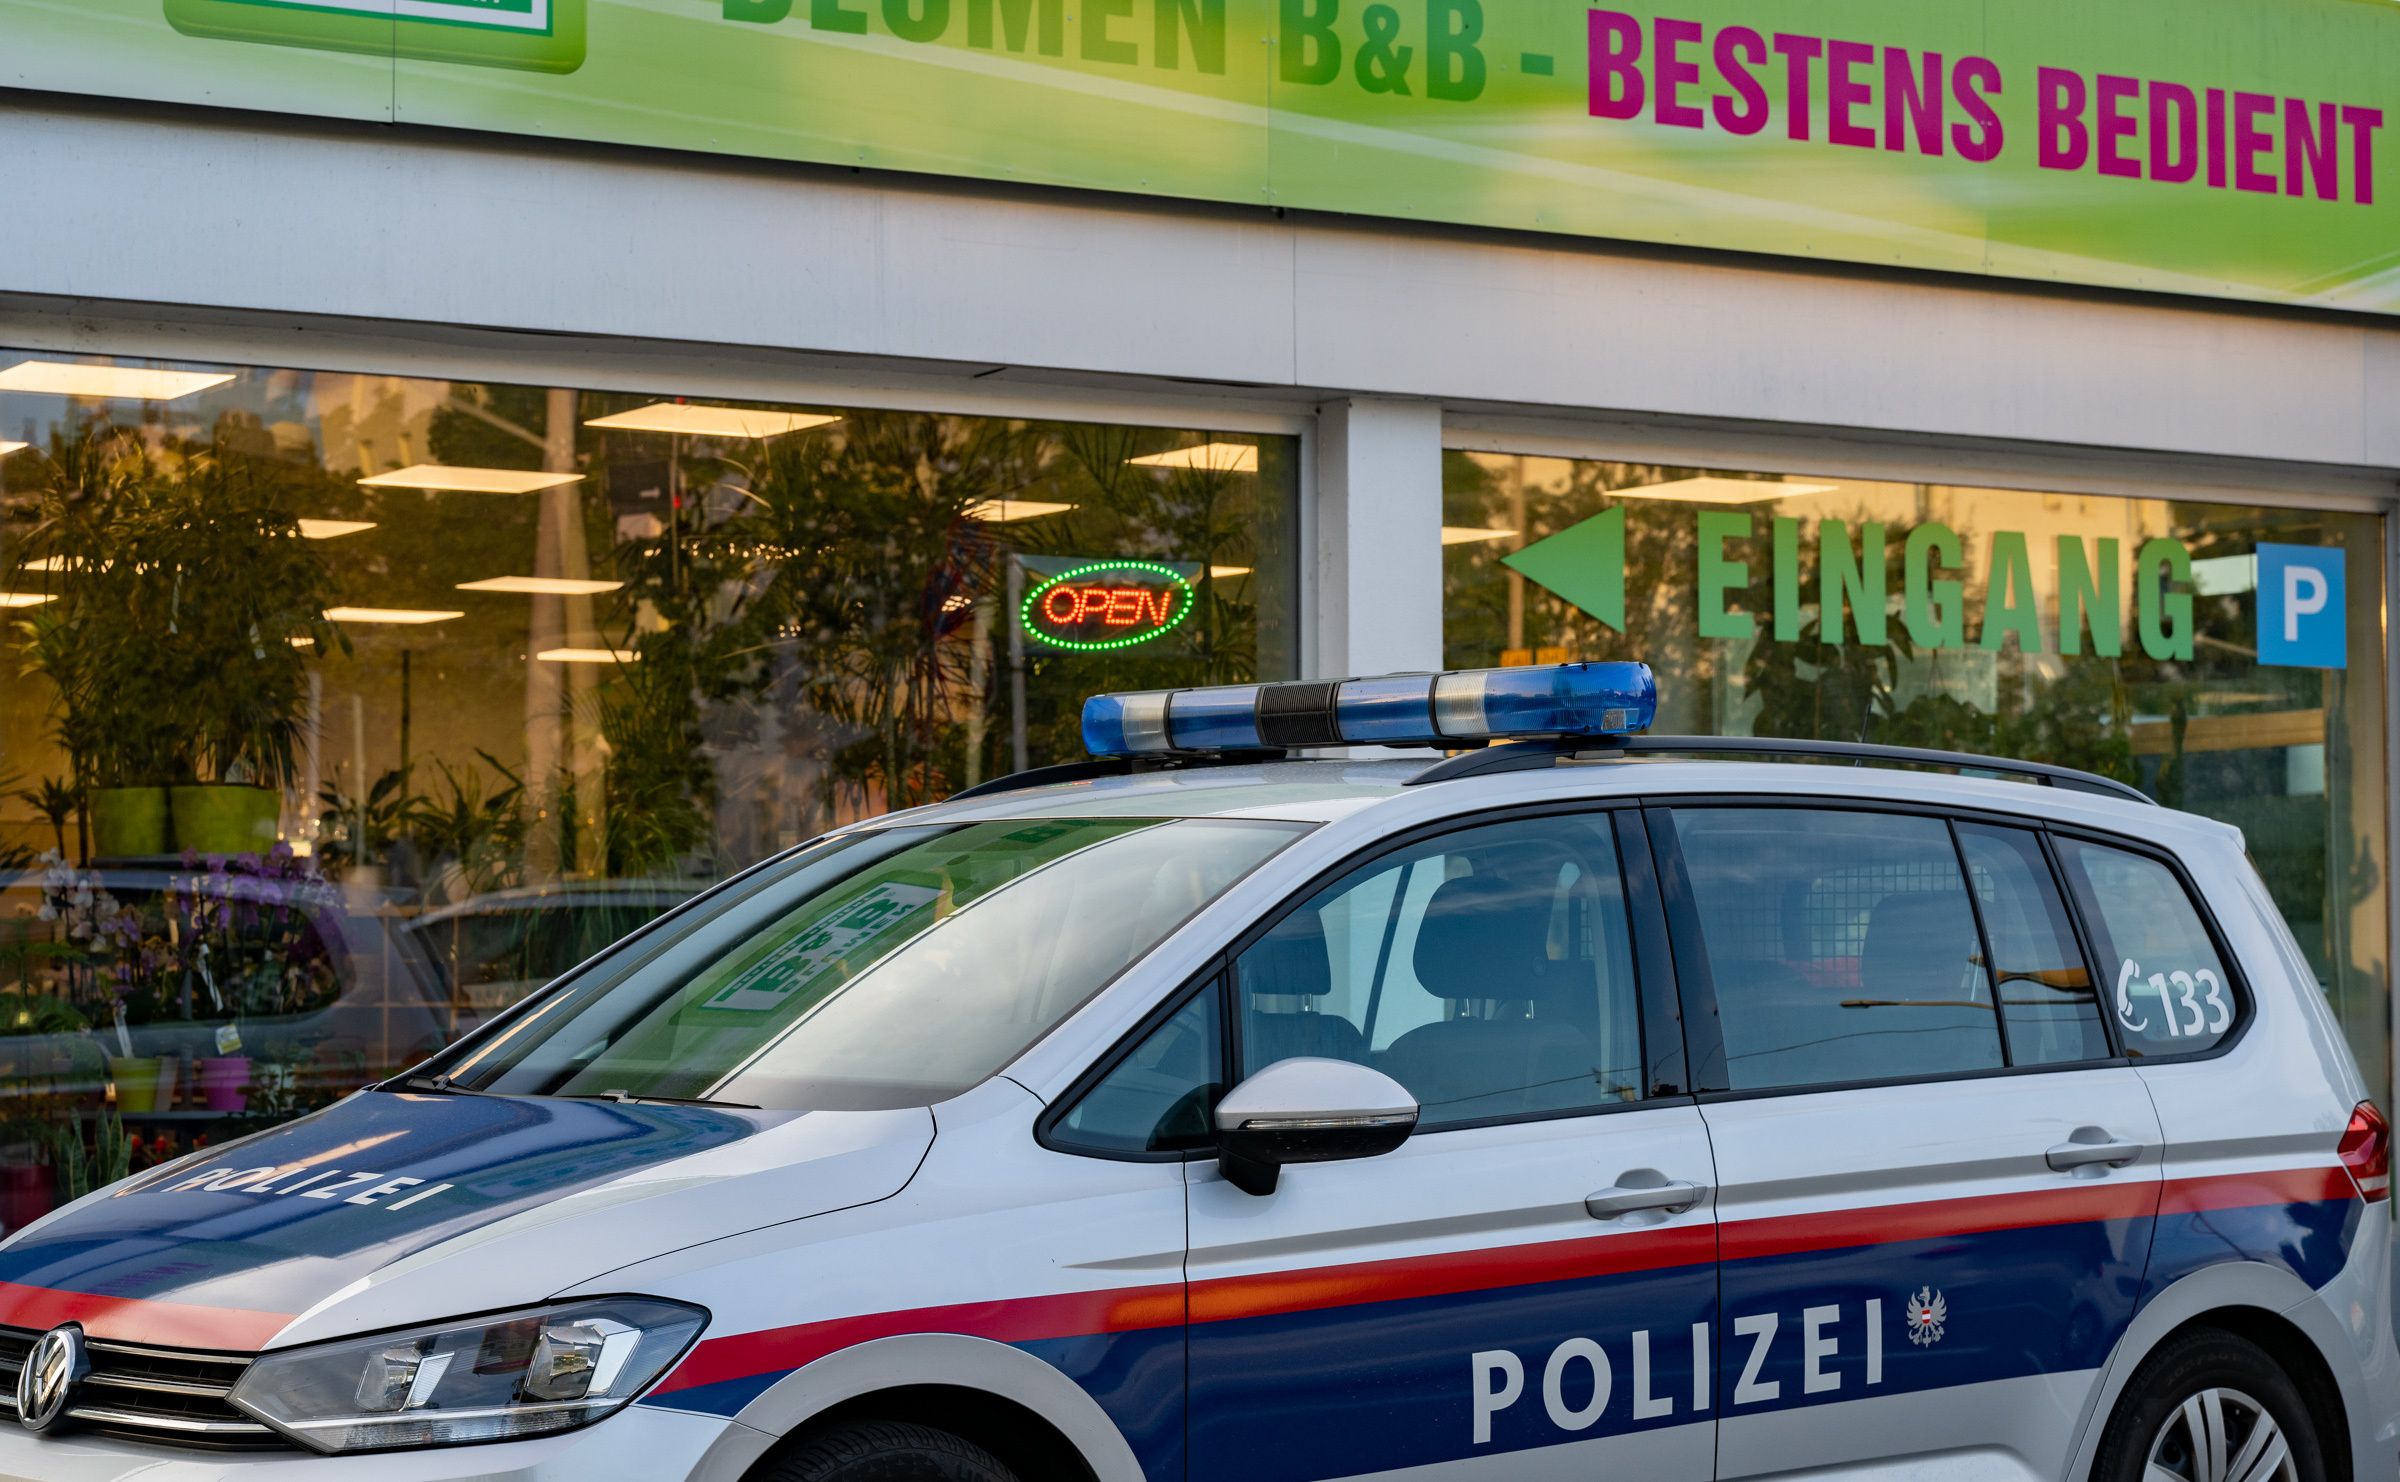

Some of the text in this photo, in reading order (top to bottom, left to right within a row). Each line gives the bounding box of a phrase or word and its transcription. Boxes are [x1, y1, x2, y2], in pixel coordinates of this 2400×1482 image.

[1280, 0, 1487, 102] B&B
[1587, 9, 2004, 163] BESTENS
[2038, 66, 2383, 206] BEDIENT
[1044, 586, 1171, 626] OPEN
[1698, 510, 2194, 662] EINGANG
[2283, 565, 2327, 642] P
[2147, 968, 2230, 1037] 133
[160, 1157, 455, 1211] POLIZEI
[1472, 1298, 1883, 1445] POLIZEI
